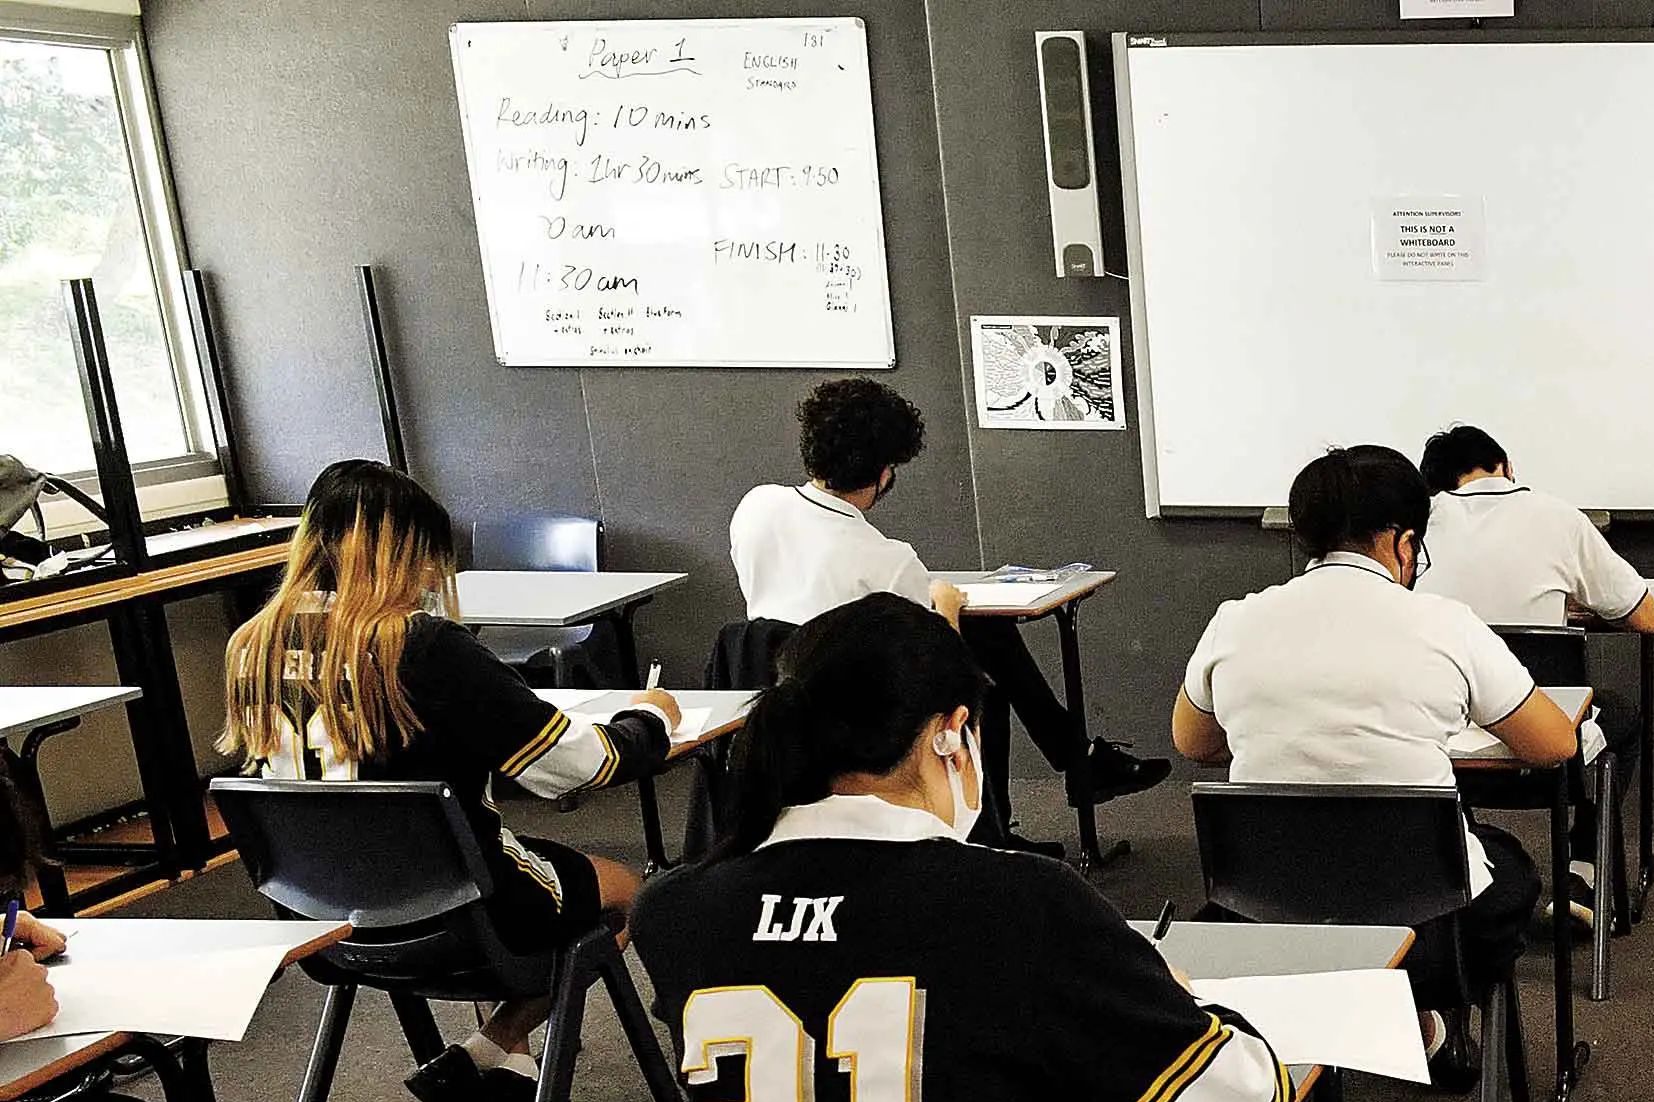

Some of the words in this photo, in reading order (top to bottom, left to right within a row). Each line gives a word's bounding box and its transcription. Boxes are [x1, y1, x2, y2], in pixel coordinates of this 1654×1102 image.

[588, 38, 658, 79] Paper
[743, 52, 799, 71] ENGLISH
[613, 104, 649, 129] 10
[654, 110, 711, 131] mins
[1400, 225, 1418, 233] THIS
[1420, 225, 1427, 233] IS
[1429, 225, 1446, 234] NOT
[1448, 225, 1455, 233] A
[1399, 239, 1456, 247] WHITEBOARD
[752, 894, 845, 942] LJX
